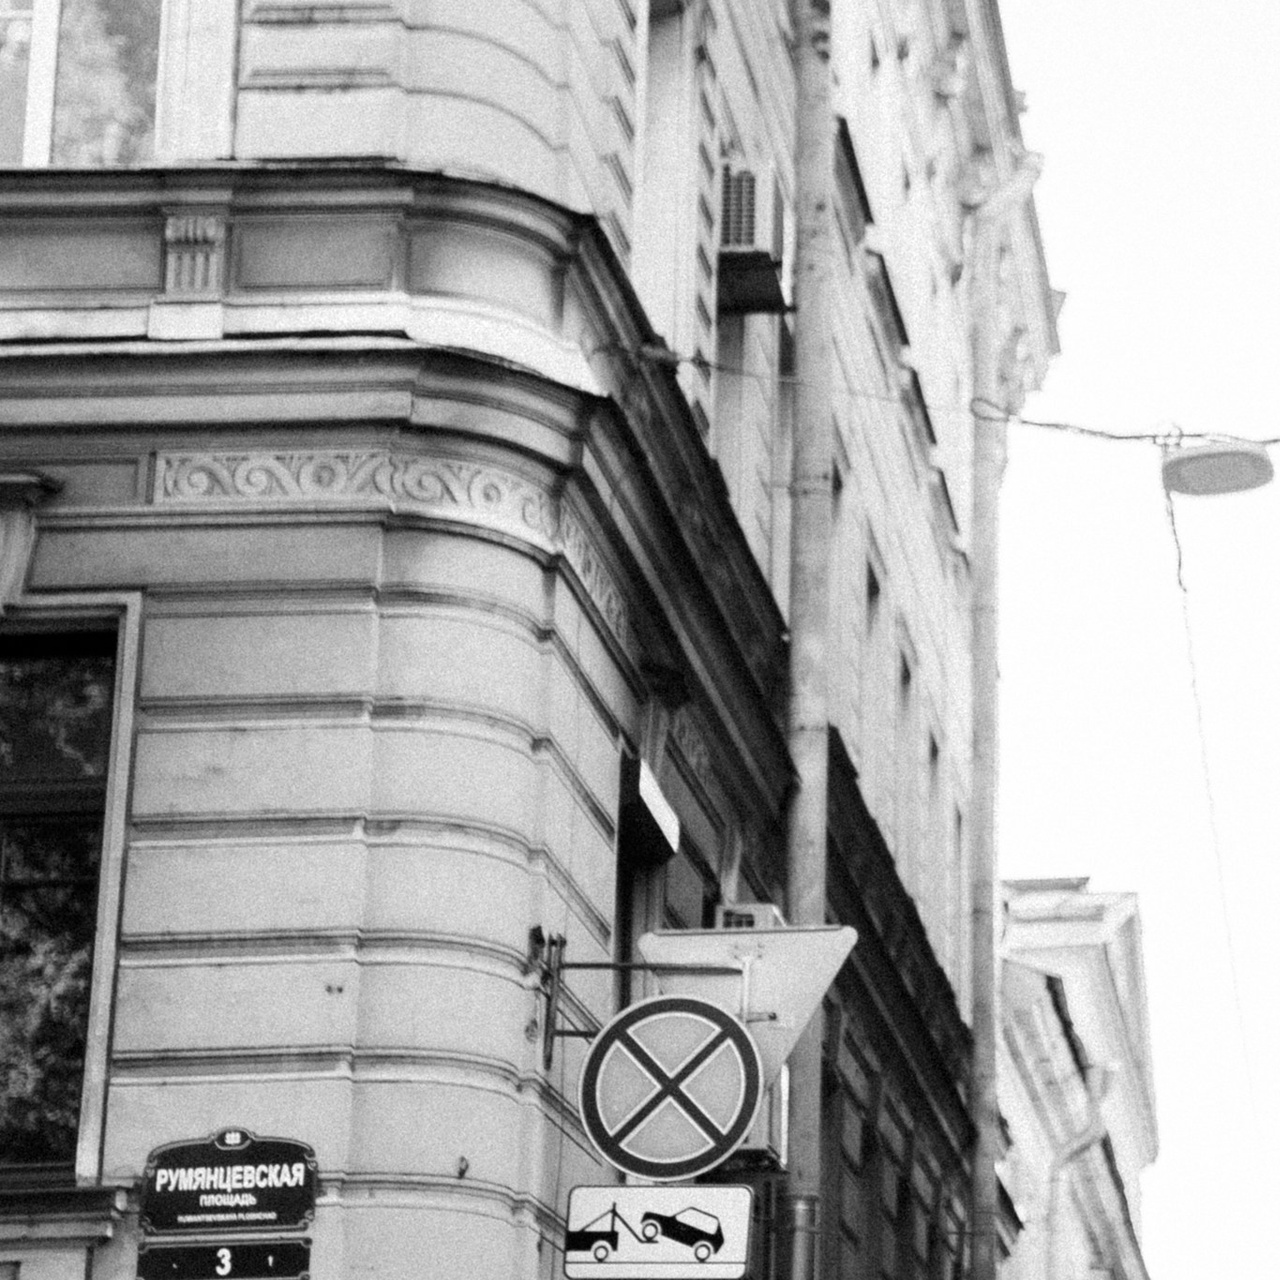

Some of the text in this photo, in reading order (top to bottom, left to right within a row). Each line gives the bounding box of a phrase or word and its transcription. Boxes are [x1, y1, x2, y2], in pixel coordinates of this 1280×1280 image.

[155, 1162, 306, 1193] РУМЯНЦЕВСКАЯ
[199, 1192, 258, 1208] ПЛОЩАДЬ
[215, 1247, 232, 1276] 3
